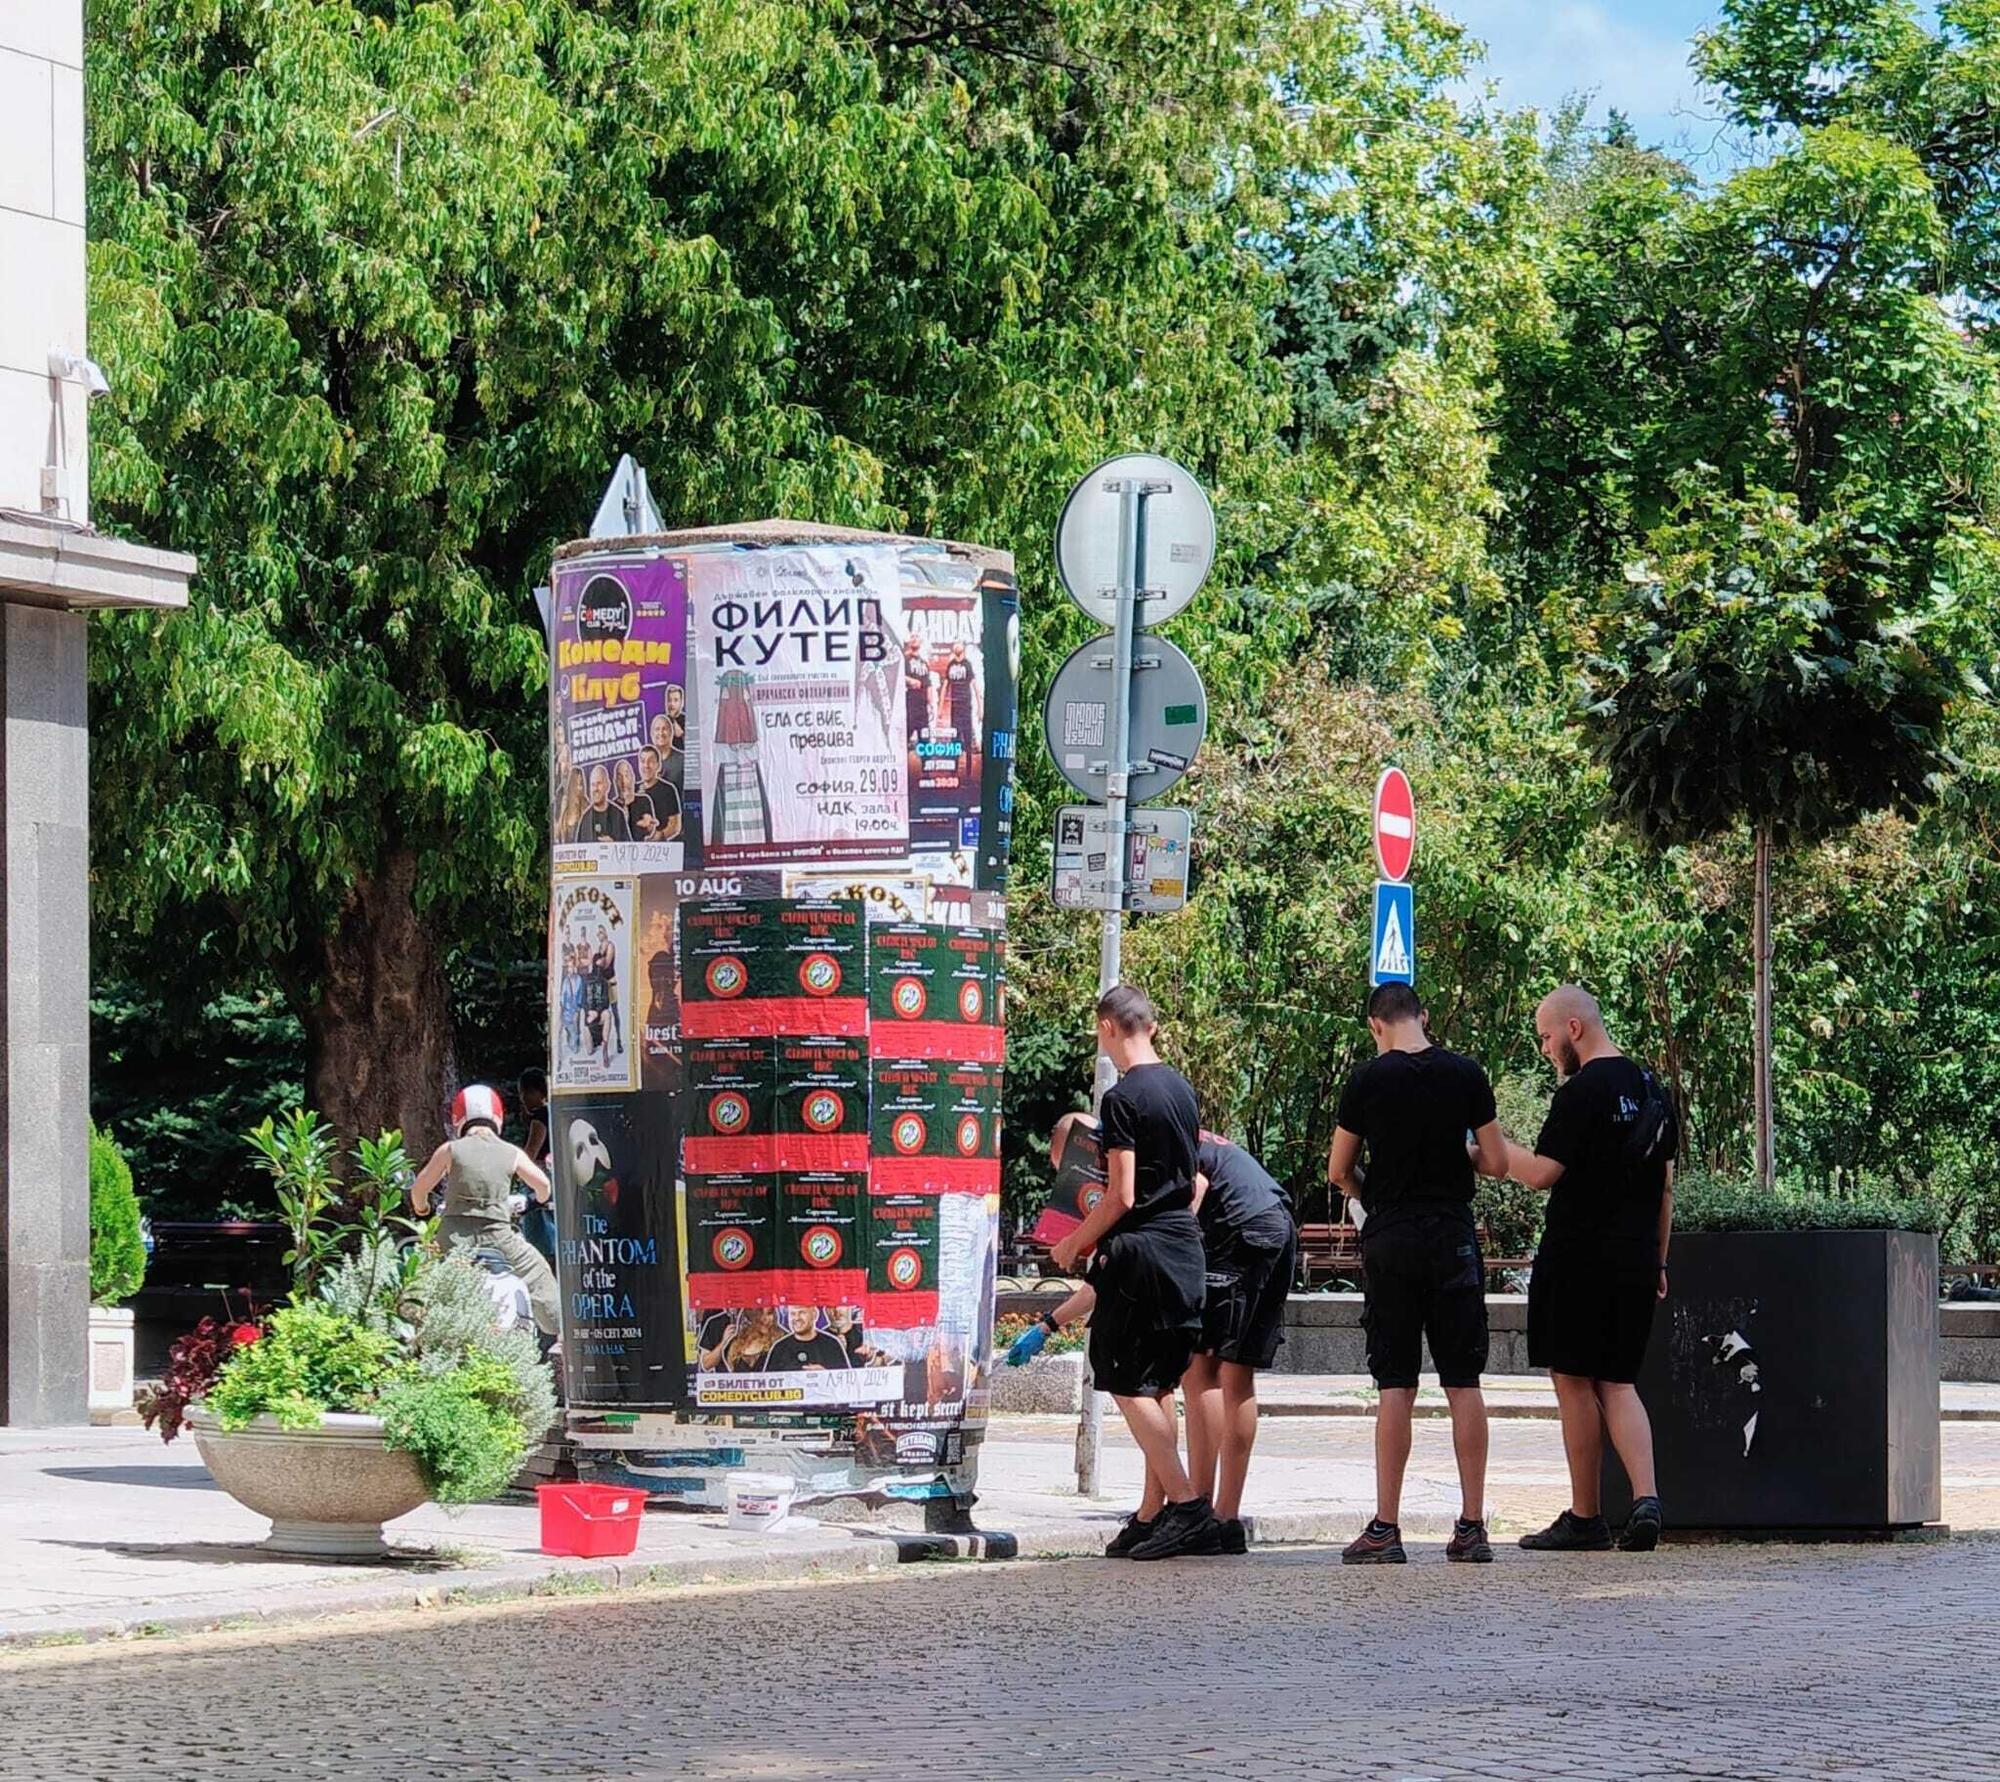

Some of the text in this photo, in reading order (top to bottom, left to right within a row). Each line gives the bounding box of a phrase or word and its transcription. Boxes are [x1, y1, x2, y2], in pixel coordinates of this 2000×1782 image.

[712, 598, 883, 632] ФИЛИП
[715, 631, 887, 668] КУТЕВ
[795, 711, 813, 727] СЕ
[916, 743, 962, 756] СОФИЯ
[643, 844, 670, 863] 2024
[675, 877, 742, 896] 10 AUG
[583, 1214, 608, 1235] The
[561, 1238, 658, 1265] PHANTOM
[582, 1268, 616, 1289] of the
[572, 1293, 637, 1320] OPERA
[621, 1328, 642, 1338] 2024
[718, 1378, 784, 1389] БИЛЕТИ ОТ
[702, 1389, 802, 1402] COMEDYCLUB.BG
